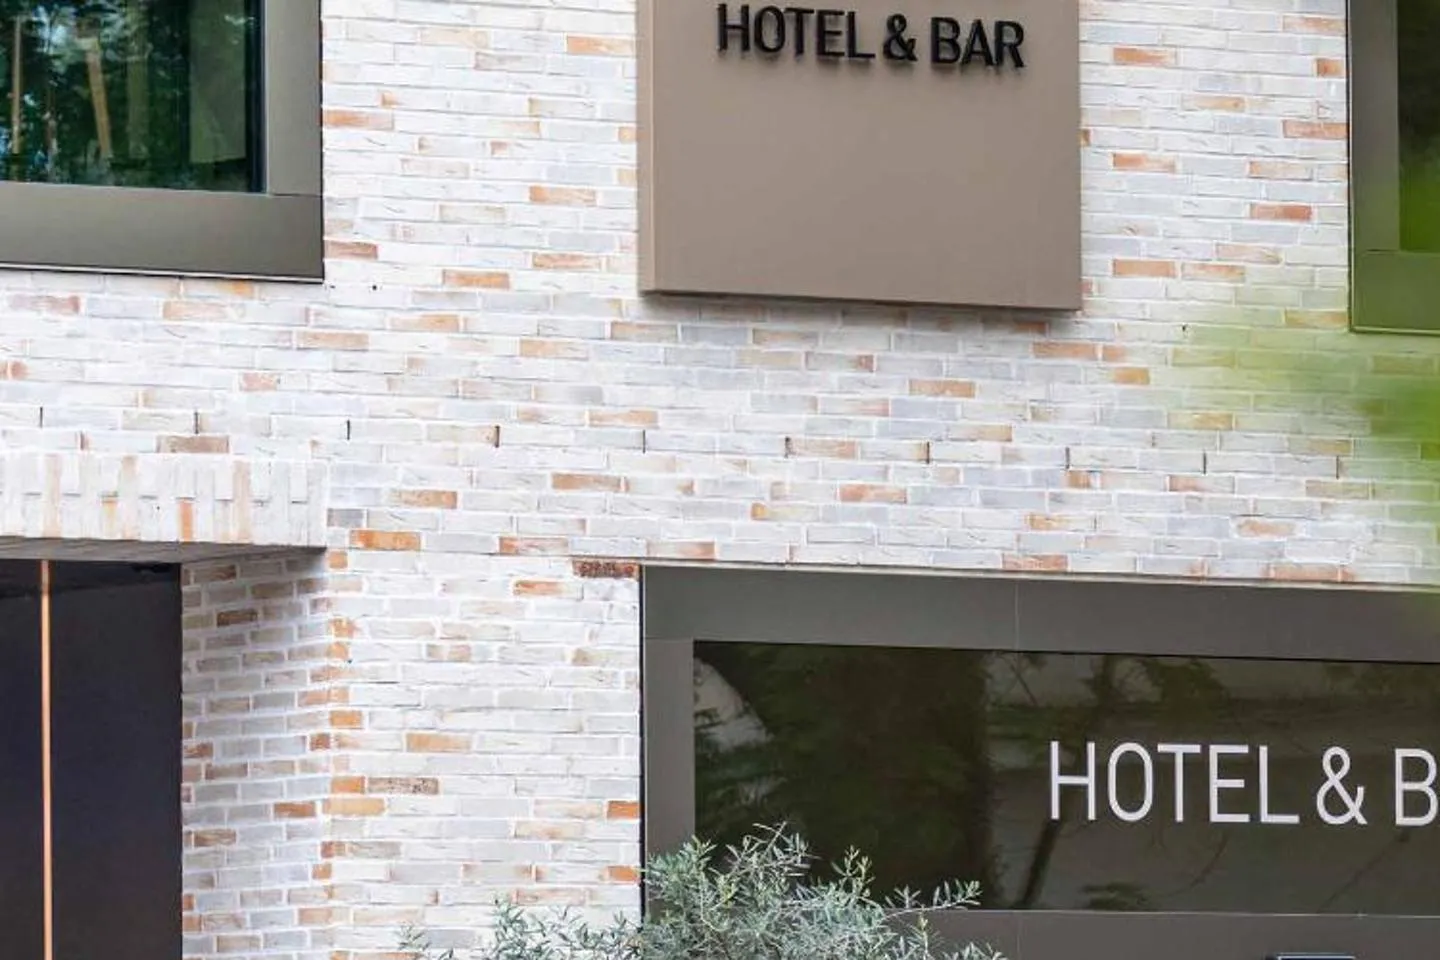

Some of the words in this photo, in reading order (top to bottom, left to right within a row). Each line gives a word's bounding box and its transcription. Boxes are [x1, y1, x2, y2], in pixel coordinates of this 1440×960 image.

[716, 3, 876, 59] HOTEL
[883, 12, 918, 63] &
[930, 15, 1025, 68] BAR
[1050, 740, 1300, 824] HOTEL
[1315, 745, 1368, 826] &
